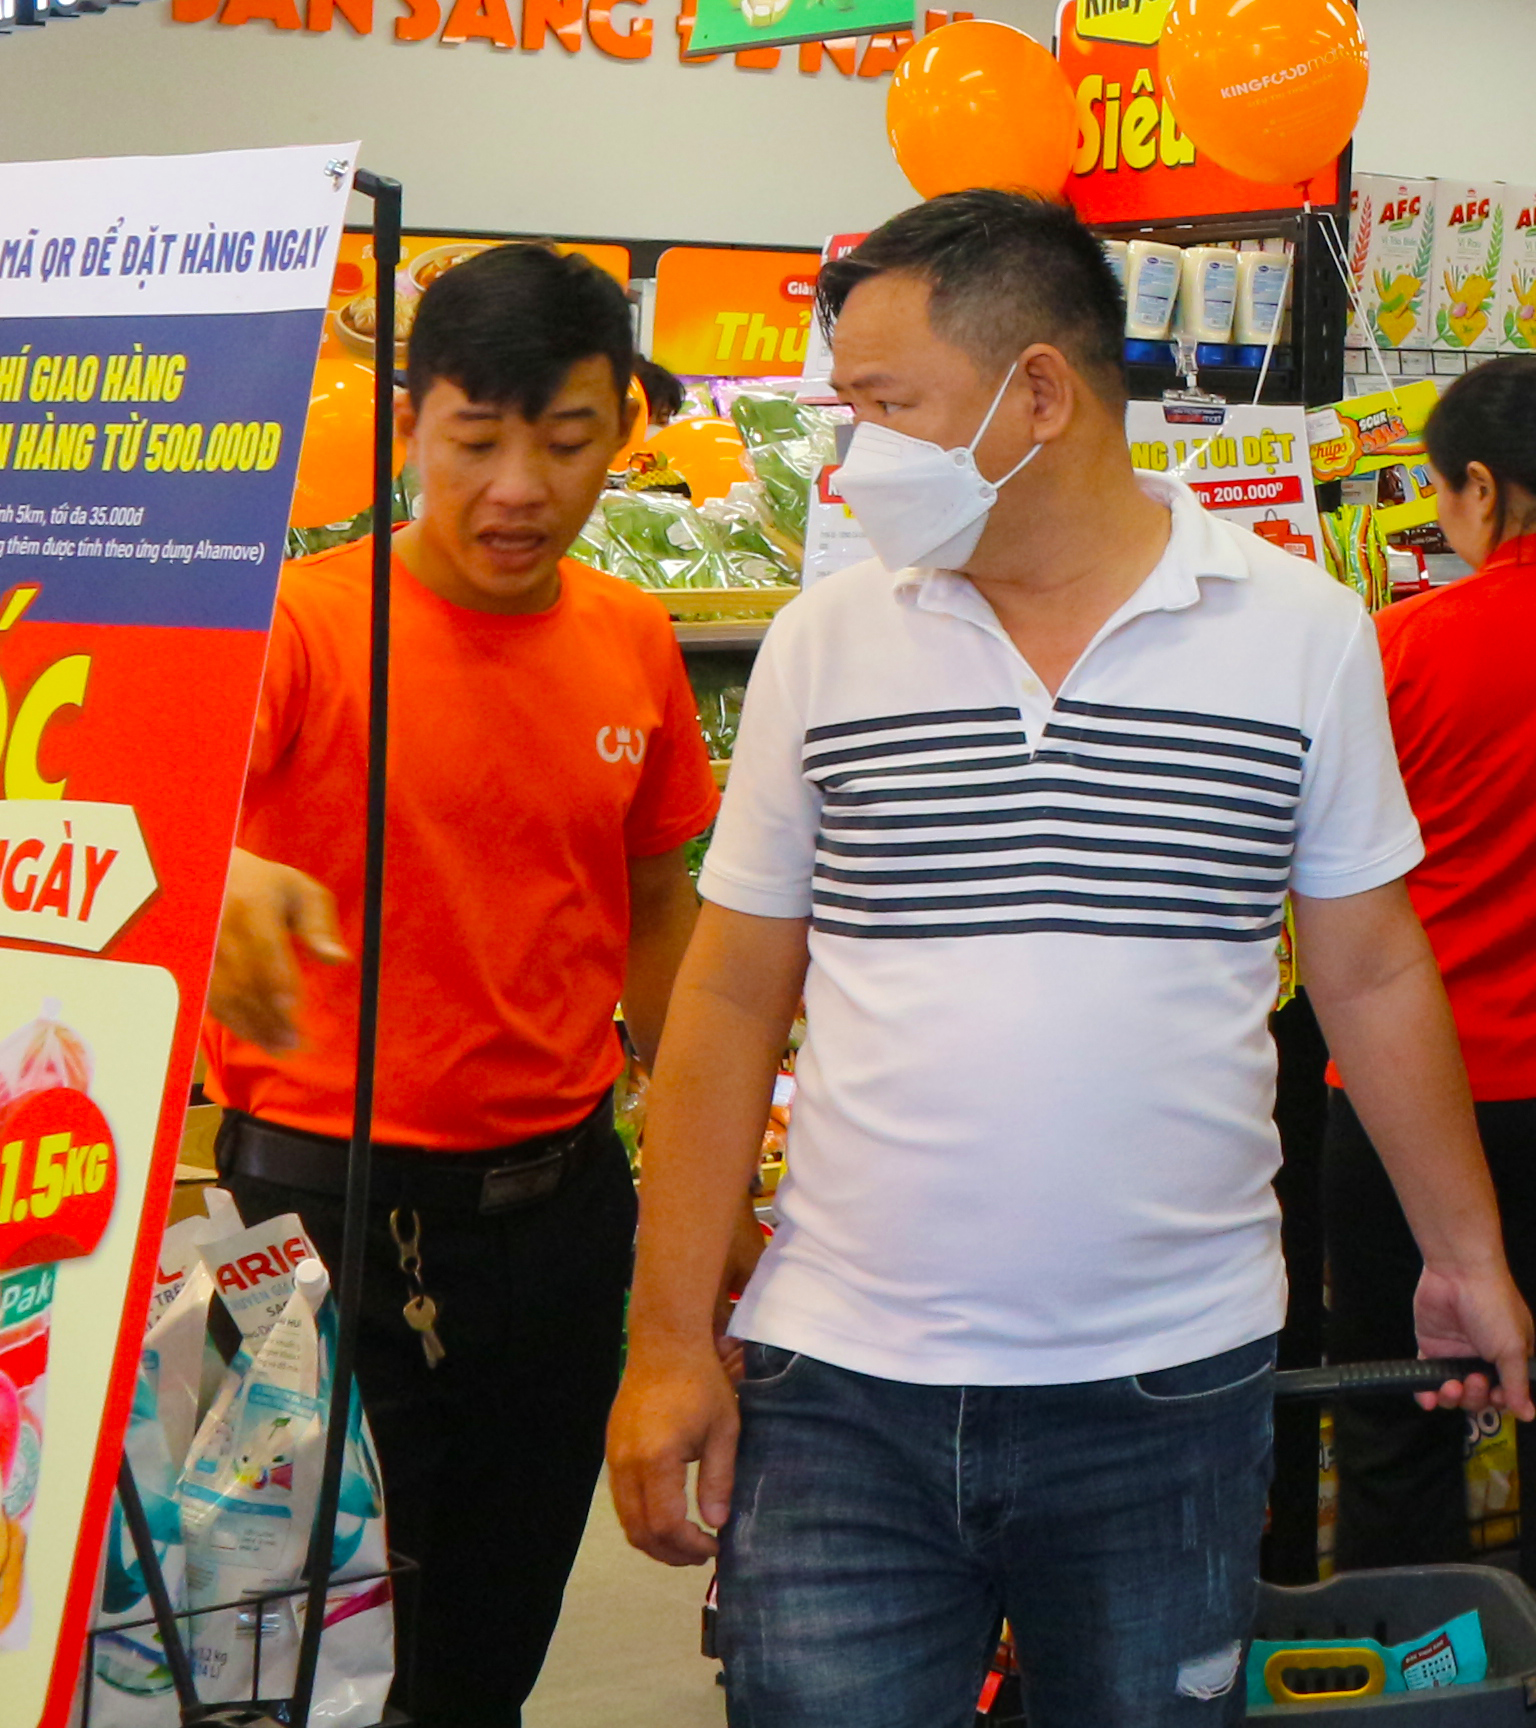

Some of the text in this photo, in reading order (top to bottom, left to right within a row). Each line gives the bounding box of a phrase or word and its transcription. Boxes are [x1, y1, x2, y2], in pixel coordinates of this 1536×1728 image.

[41, 217, 329, 289] QR ĐỂ ĐẶT HÀNG NGAY
[29, 344, 186, 403] GIAO HÀNG
[14, 412, 281, 471] HÀNG TỪ 500.000Đ
[1192, 428, 1294, 474] TÚI DỆT
[16, 502, 144, 526] 5km, tối đa 35.000đ
[7, 536, 193, 564] thêm được tính theo ứng dụng
